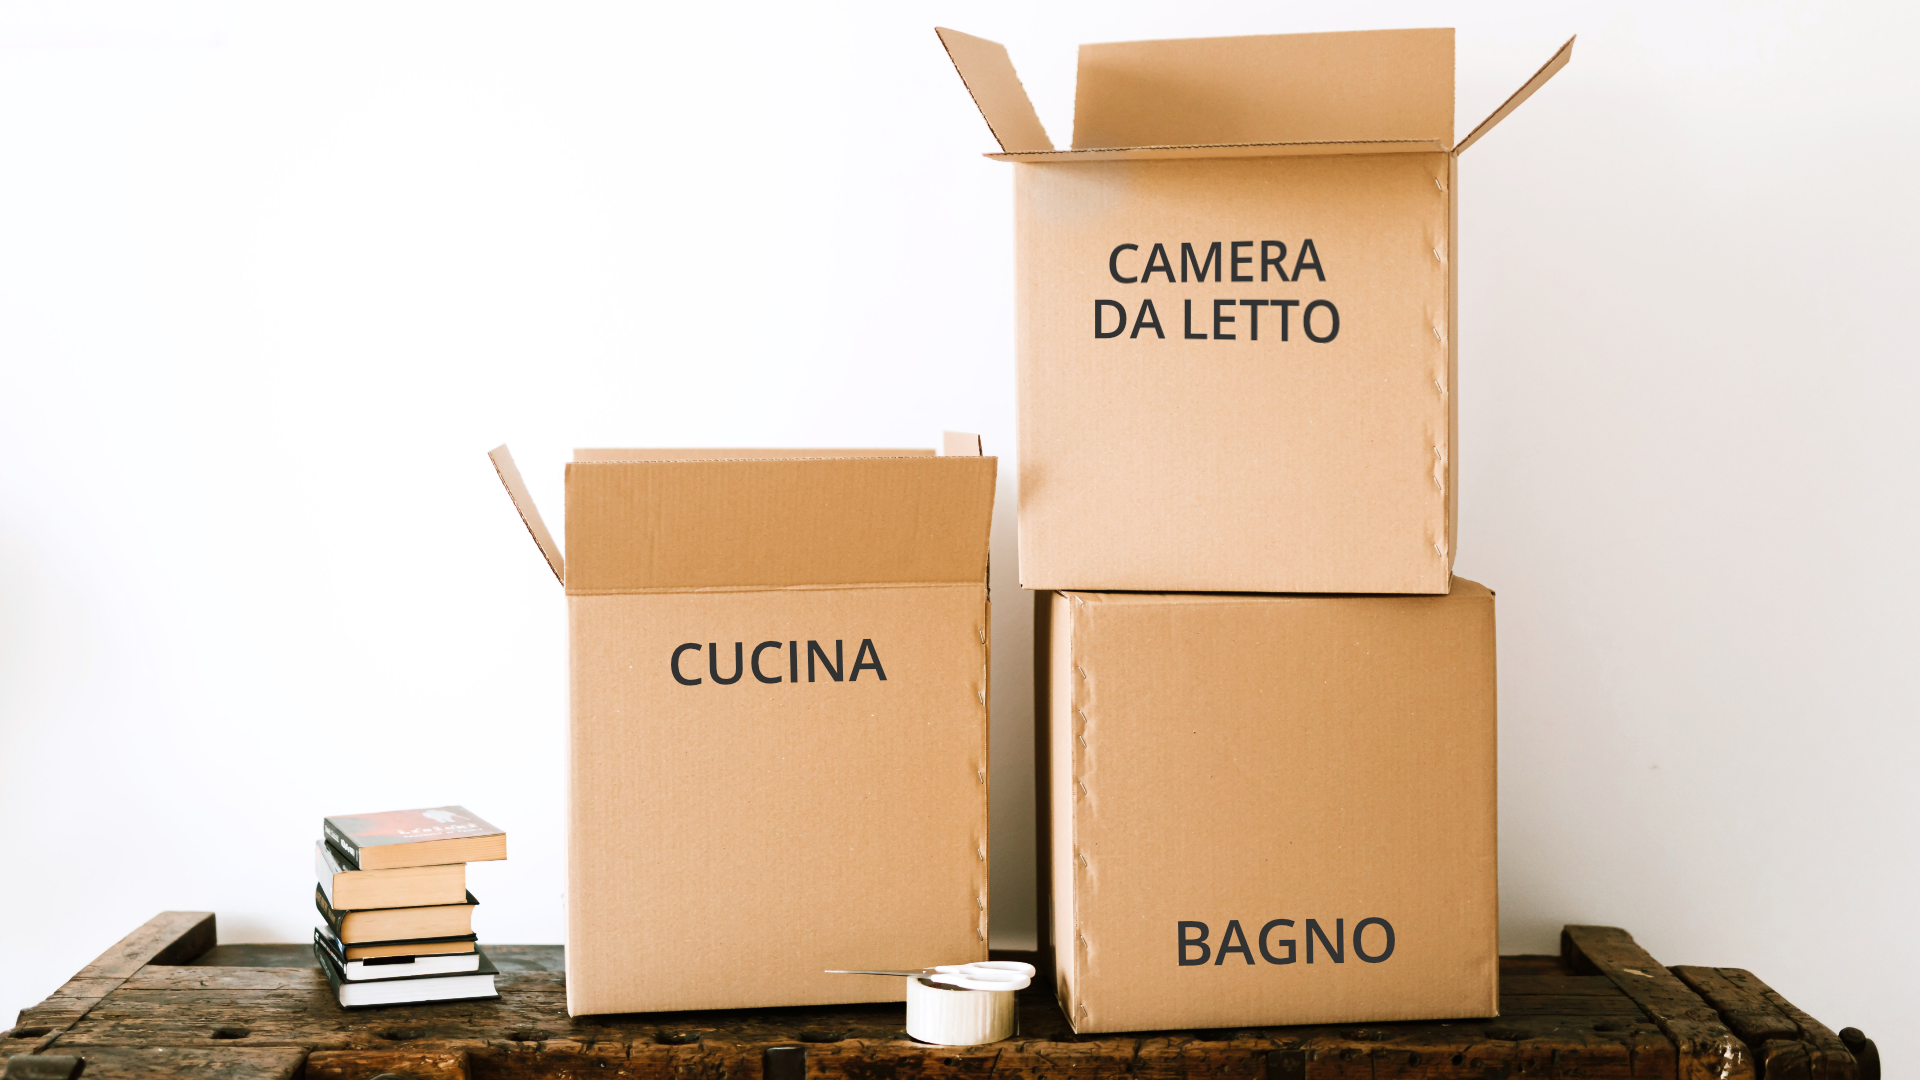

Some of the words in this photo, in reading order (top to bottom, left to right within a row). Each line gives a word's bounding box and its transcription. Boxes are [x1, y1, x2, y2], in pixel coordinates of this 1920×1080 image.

[1108, 238, 1326, 284] CAMERA
[1093, 298, 1166, 340] DA
[1183, 299, 1341, 344] LETTO
[669, 638, 888, 686] CUCINA
[1177, 916, 1396, 967] BAGNO
